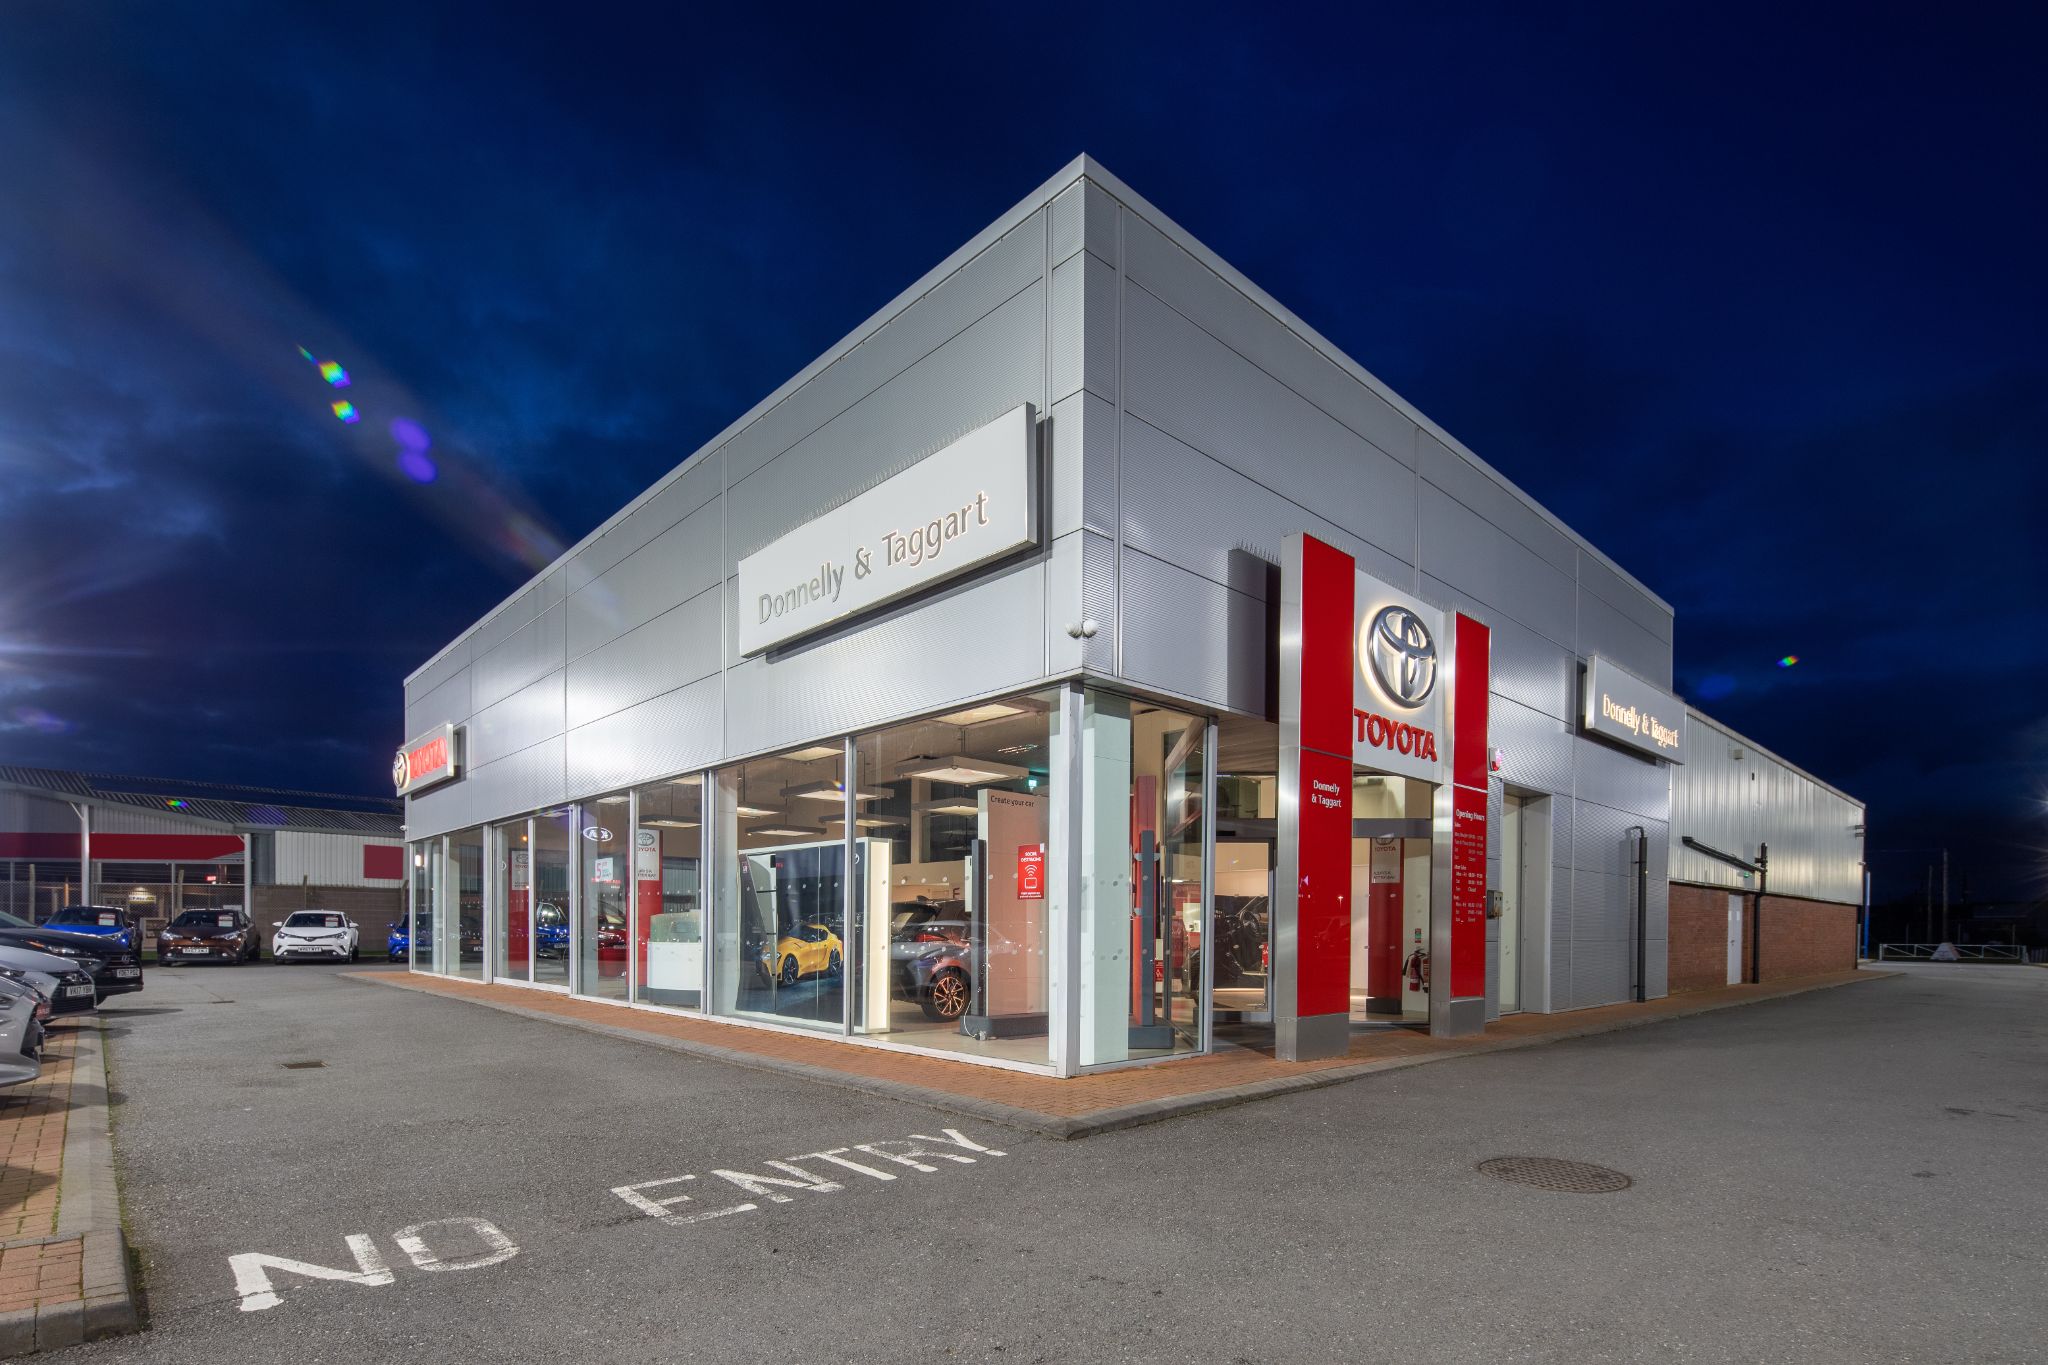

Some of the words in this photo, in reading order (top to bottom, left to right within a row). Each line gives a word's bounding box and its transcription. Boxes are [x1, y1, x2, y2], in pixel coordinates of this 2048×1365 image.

[759, 561, 844, 624] Donnelly
[854, 546, 873, 580] &
[881, 491, 989, 568] Taggart
[1353, 708, 1437, 762] TOYOTA
[1603, 693, 1640, 735] Donnelly
[1642, 712, 1649, 735] &
[1651, 716, 1678, 748] Taggart
[408, 736, 448, 779] TOYOTA
[990, 795, 1010, 804] Create
[1311, 793, 1317, 803] &
[1318, 795, 1341, 808] Taggart
[1313, 780, 1340, 796] Donnelly
[1456, 808, 1473, 821] Opening
[228, 1217, 521, 1311] NO
[610, 1129, 1008, 1226] ENTRY
